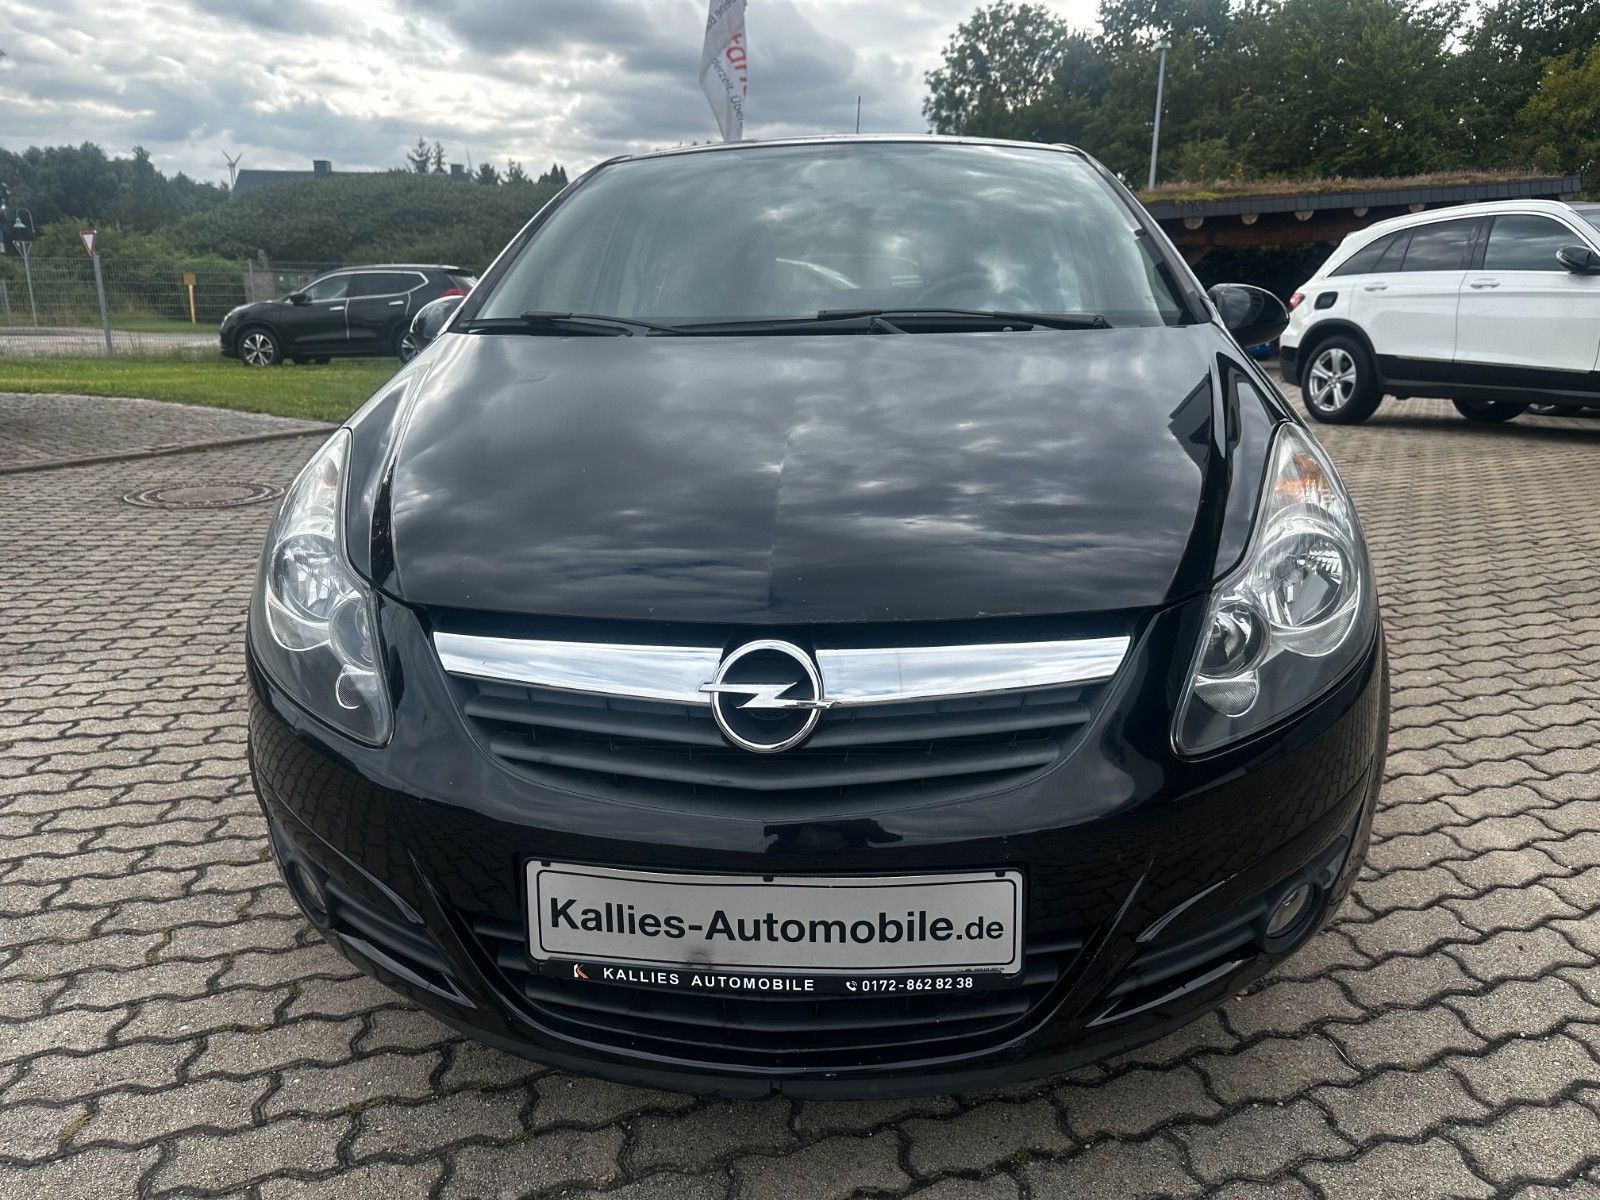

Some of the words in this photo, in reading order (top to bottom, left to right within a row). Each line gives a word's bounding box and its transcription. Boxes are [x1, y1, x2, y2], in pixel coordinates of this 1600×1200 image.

[550, 897, 1005, 943] Kallies-Automobile.de
[603, 967, 679, 985] KALLIES
[691, 975, 814, 991] AUTOMOBILE
[936, 977, 953, 989] 82
[956, 977, 973, 989] 38
